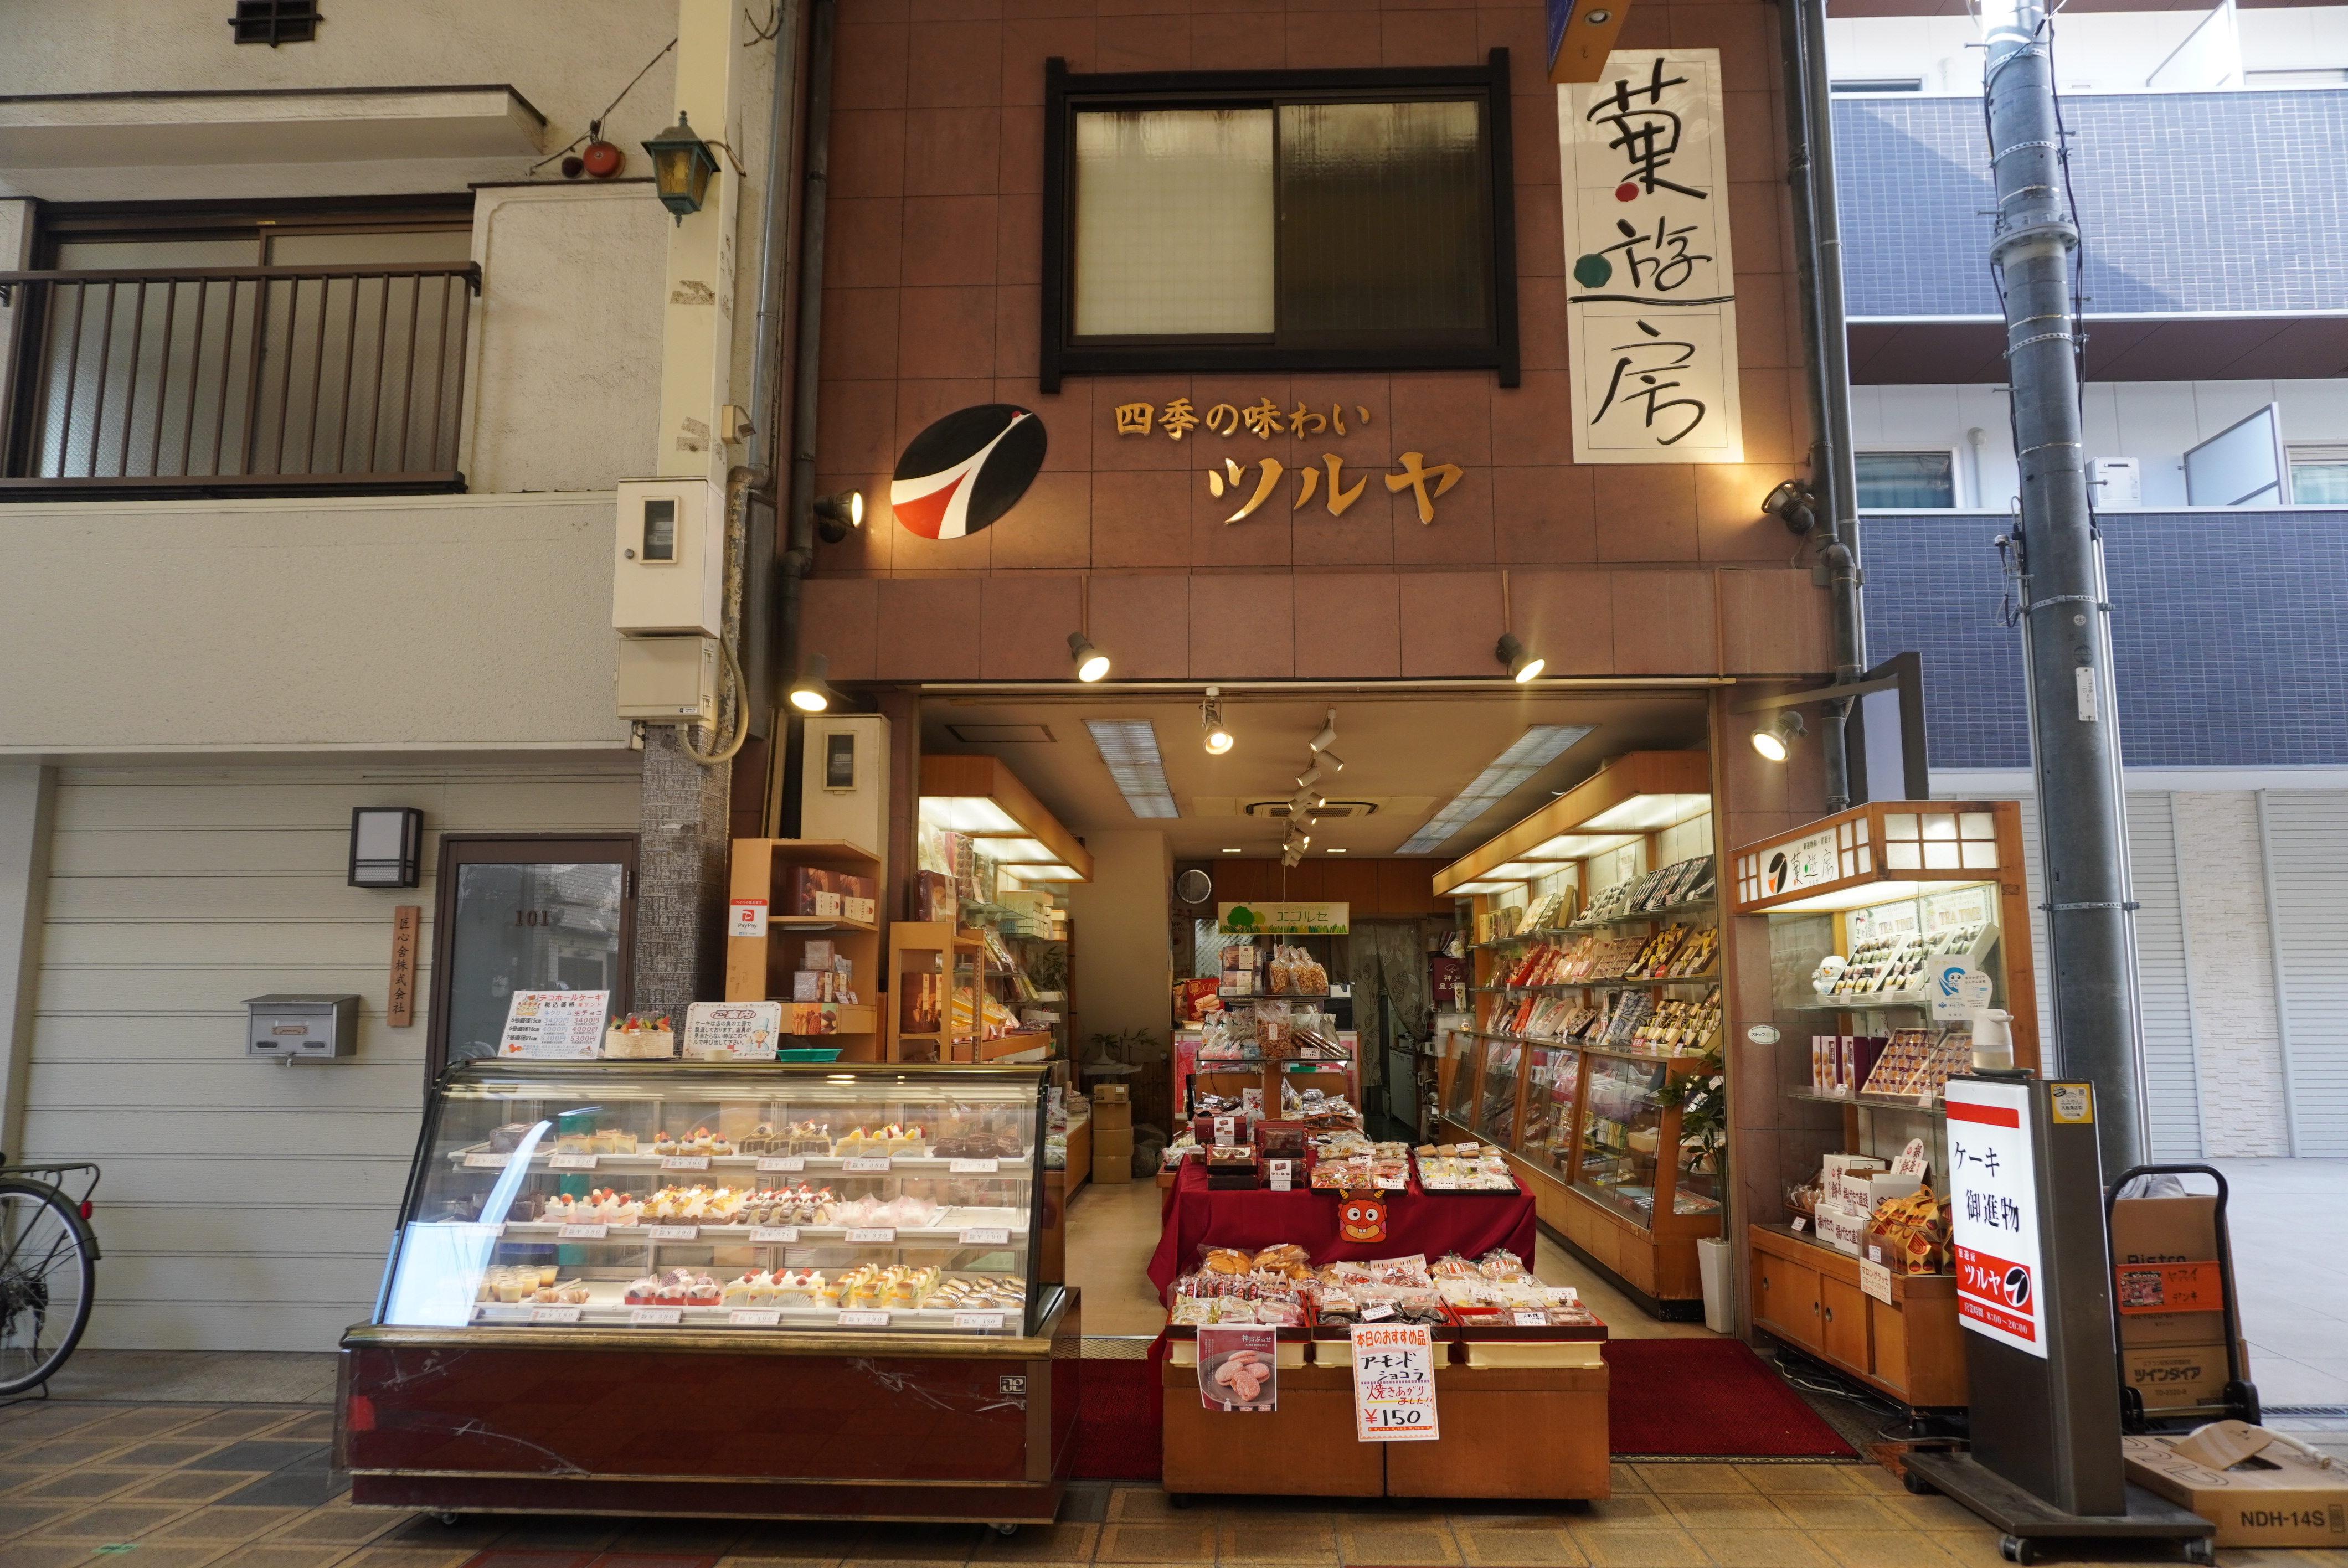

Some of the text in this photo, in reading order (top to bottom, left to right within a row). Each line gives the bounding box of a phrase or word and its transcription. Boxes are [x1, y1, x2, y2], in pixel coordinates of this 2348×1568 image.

[1115, 397, 1370, 441] 四季の味わい
[1209, 452, 1464, 525] ツルヤ
[515, 910, 548, 927] 101
[1276, 911, 1329, 922] エコルセ
[1939, 906, 1981, 925] TEA TIME
[1878, 917, 1914, 935] TEA TIME
[713, 1009, 753, 1019] ご案内
[1954, 1142, 2000, 1178] ケーキ
[1966, 1189, 2019, 1233] 御進物
[1958, 1248, 1976, 1262] 菓遊房
[1861, 1266, 1889, 1286] マロングラッセ
[1964, 1263, 2001, 1296] ツルヤ
[1964, 1302, 1984, 1318] 営業時間
[1242, 1334, 1271, 1343] 神戸ぶっせ
[1357, 1329, 1427, 1348] 本日のおすすめ品
[1360, 1351, 1417, 1370] アーモンド
[1378, 1369, 1424, 1381] ショコラ
[2134, 1366, 2201, 1383] ツインダイア
[1367, 1383, 1424, 1401] 焼きあがり
[2241, 1510, 2324, 1527] NDH-14S
